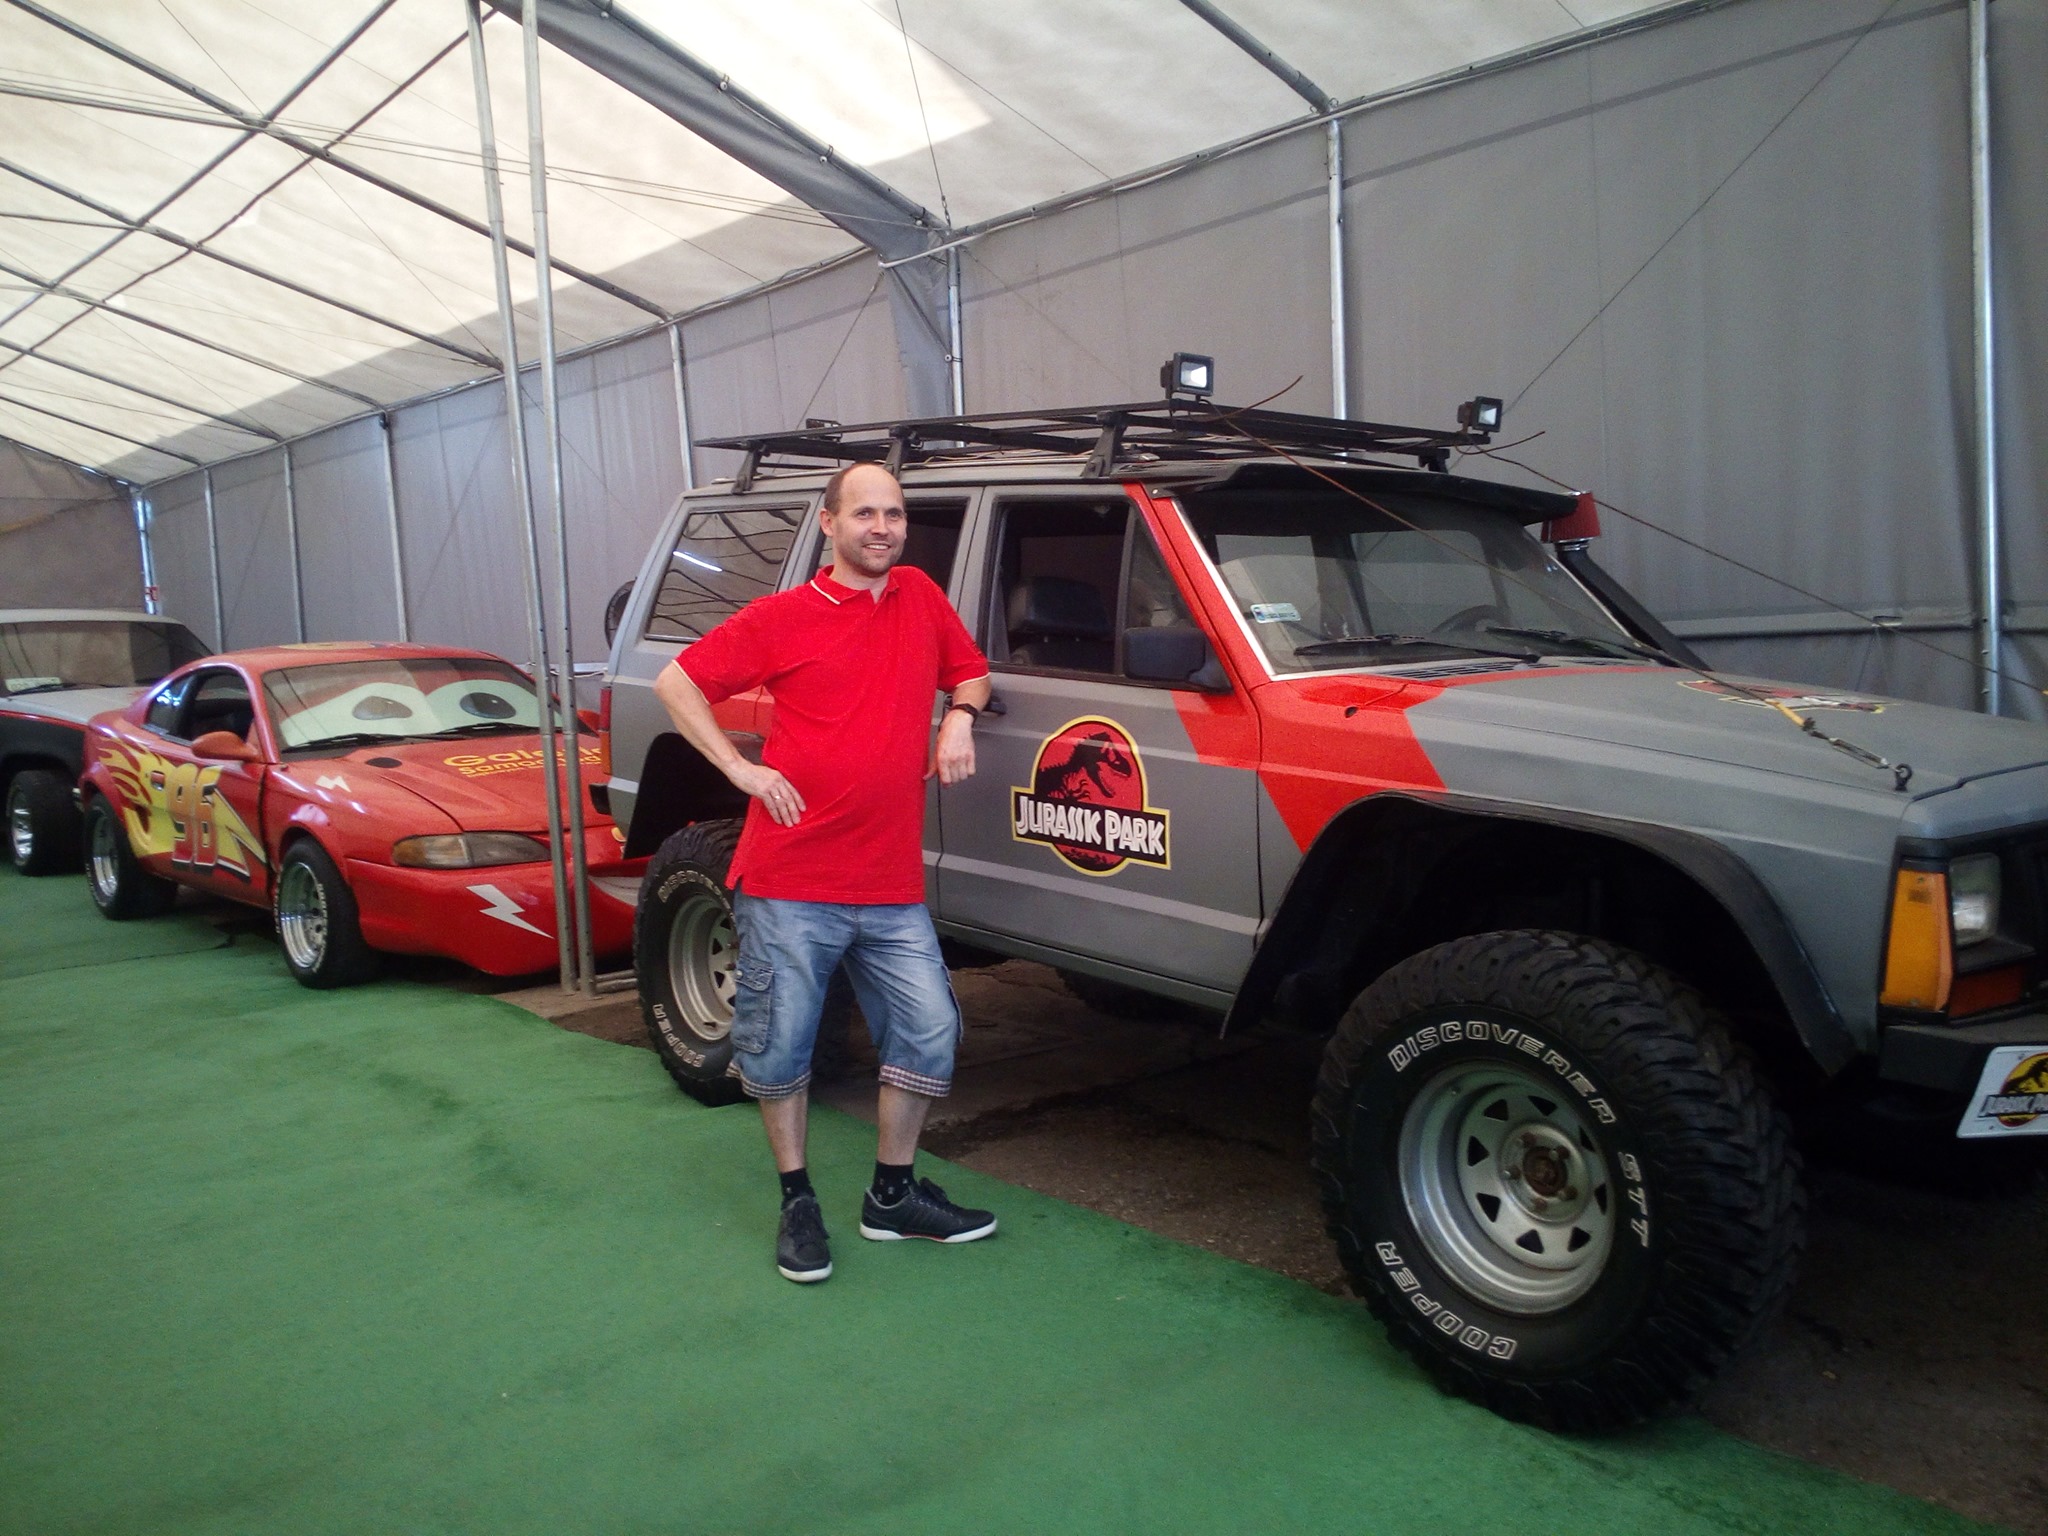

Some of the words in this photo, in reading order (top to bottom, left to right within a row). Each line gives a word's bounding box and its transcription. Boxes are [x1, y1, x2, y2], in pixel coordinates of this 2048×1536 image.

[1016, 796, 1102, 845] JURASSIC
[1104, 809, 1166, 856] PARK
[653, 1003, 706, 1068] COOPER
[1388, 1021, 1617, 1125] DISCOVERER
[1617, 1151, 1649, 1248] STT
[1375, 1241, 1518, 1361] COOPER
